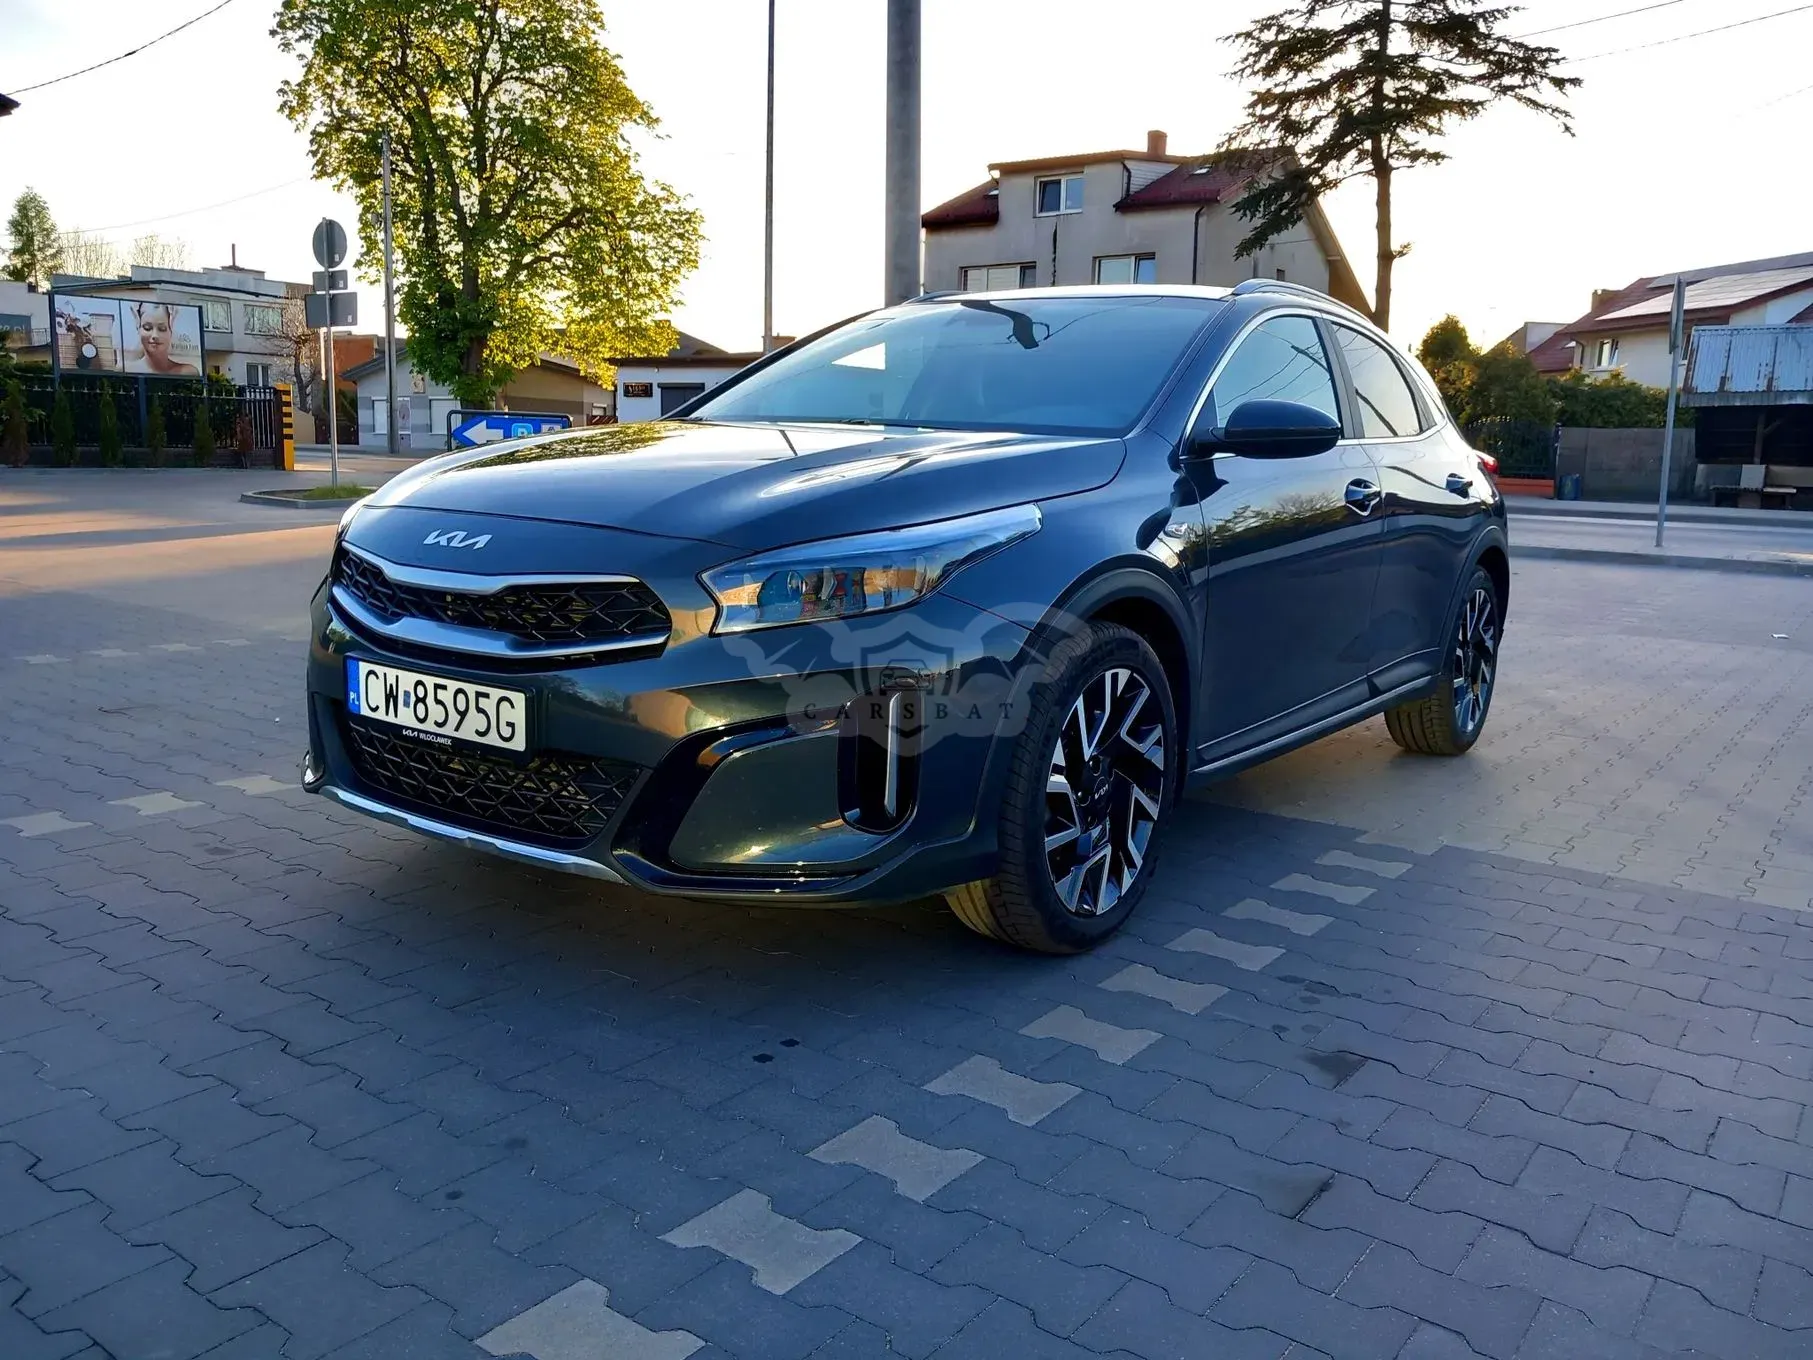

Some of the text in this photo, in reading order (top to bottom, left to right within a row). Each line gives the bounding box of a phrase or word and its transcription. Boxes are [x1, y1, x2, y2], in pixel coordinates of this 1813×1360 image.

[423, 529, 493, 550] KIA
[350, 691, 359, 705] PL
[364, 669, 516, 743] CW 8595G
[402, 729, 418, 738] KIA
